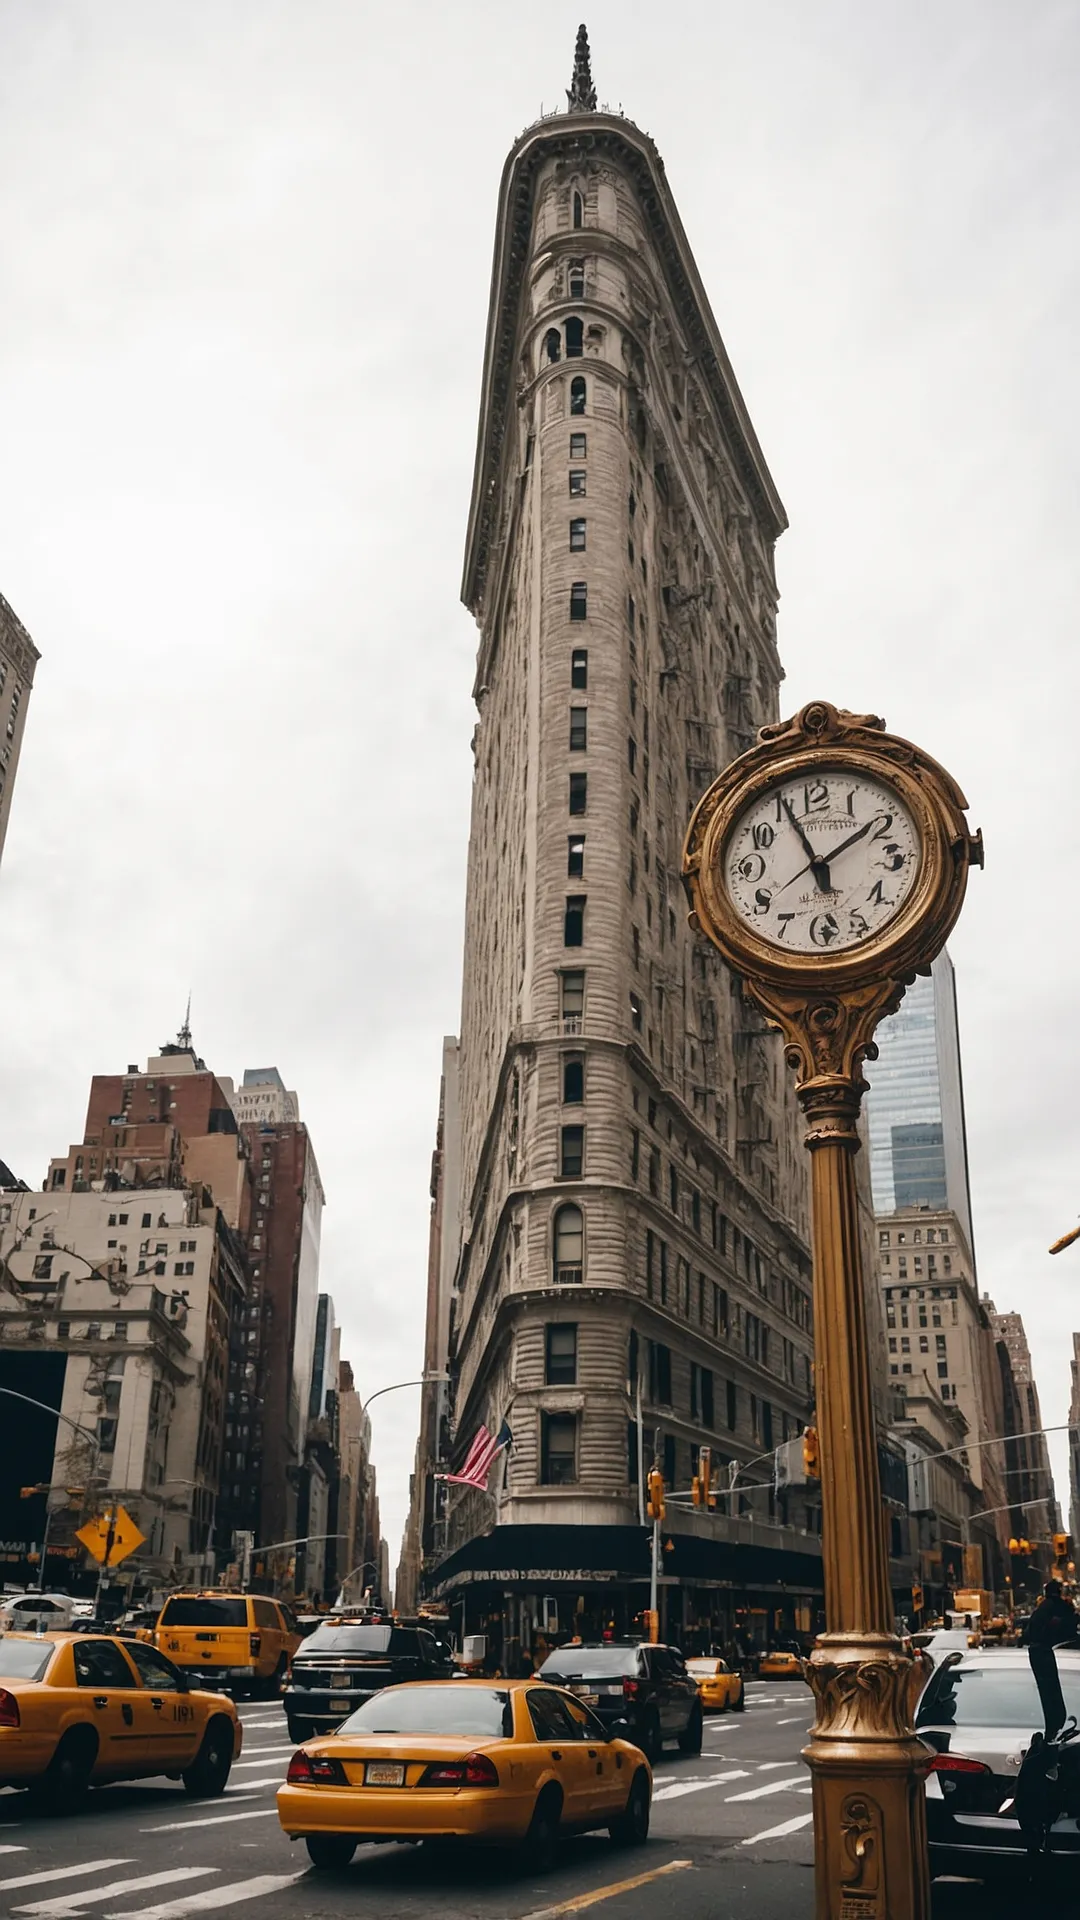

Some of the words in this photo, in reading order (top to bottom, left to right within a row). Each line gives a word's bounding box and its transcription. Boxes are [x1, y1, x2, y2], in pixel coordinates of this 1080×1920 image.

[804, 783, 830, 814] 12
[752, 822, 775, 850] 10
[778, 912, 795, 939] 7
